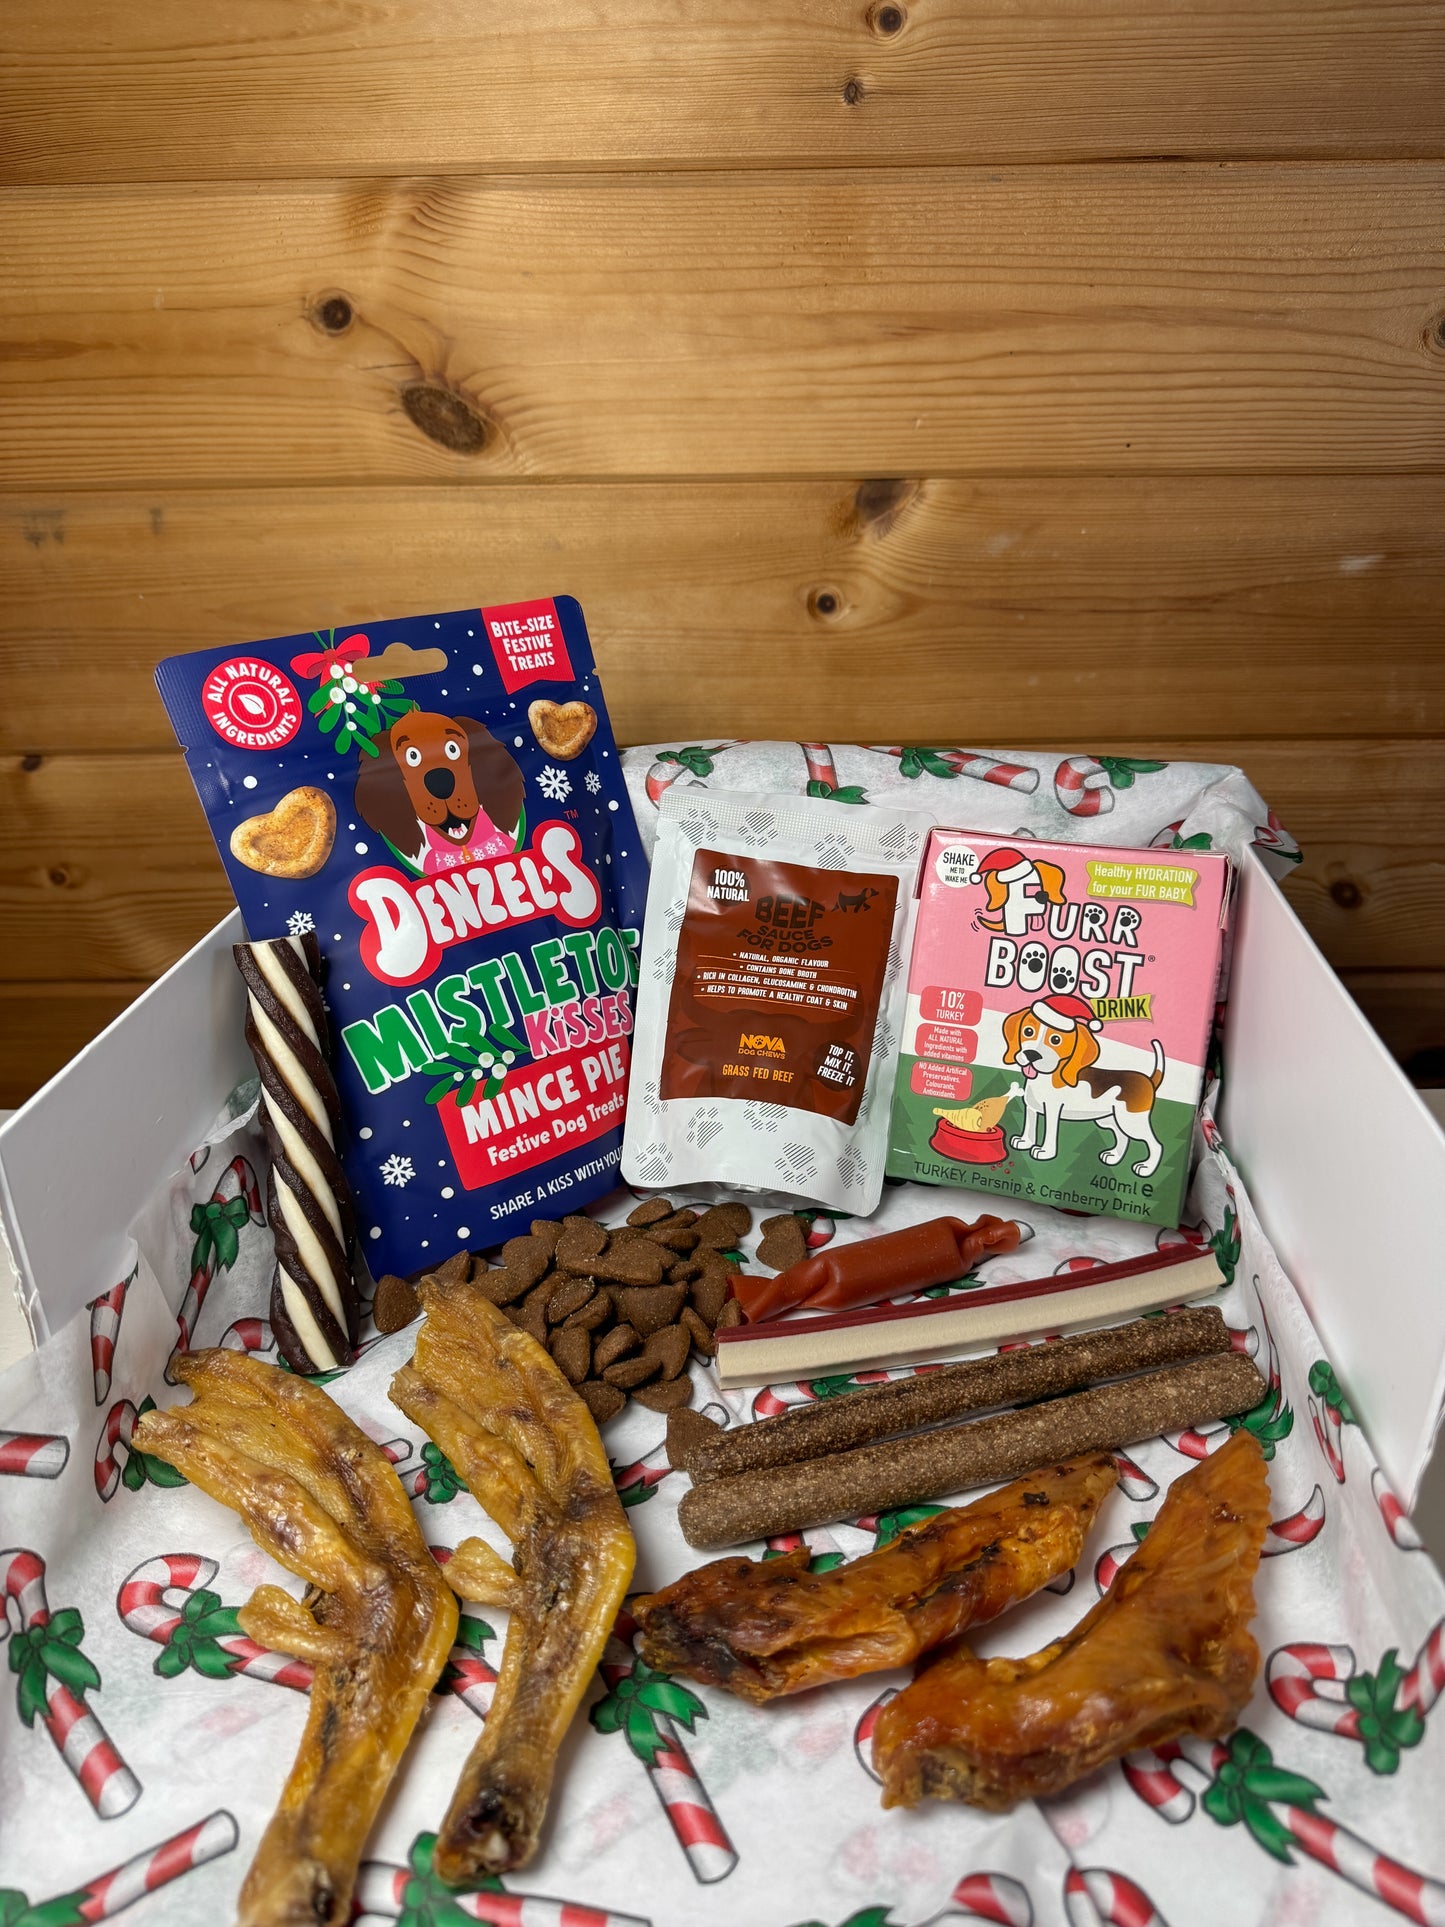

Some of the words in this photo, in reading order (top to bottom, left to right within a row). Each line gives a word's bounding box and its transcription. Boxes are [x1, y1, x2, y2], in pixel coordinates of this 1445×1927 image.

[490, 614, 555, 638] BITE-SIZE
[502, 633, 554, 655] FESTIVE
[508, 651, 556, 672] TREATS
[207, 676, 229, 704] ALL
[224, 662, 294, 706] NATURAL
[212, 711, 297, 746] INGREDIENTS
[942, 851, 976, 867] SHAKE
[714, 868, 746, 888] 100%
[945, 875, 959, 883] WAKE
[959, 876, 968, 884] ME
[958, 867, 965, 875] TO
[1094, 864, 1133, 882] Healthy
[1135, 867, 1193, 884] HYDRATION
[706, 885, 750, 902] NATURAL
[1092, 881, 1107, 894] for
[1109, 885, 1133, 897] your
[1135, 884, 1156, 898] FUR
[1158, 886, 1187, 900] BABY
[355, 826, 598, 978] DENZEL'S
[755, 893, 826, 929] BEEF
[1003, 862, 1143, 948] FURR
[736, 927, 775, 952] FOR
[777, 935, 834, 954] DOGS
[757, 925, 816, 941] SAUCE
[746, 964, 777, 974] CONTAINS
[778, 968, 795, 977] BONE
[797, 970, 818, 979] BROTH
[771, 955, 799, 965] ORGANIC
[800, 958, 830, 968] FLAVOUR
[984, 935, 1146, 1001] BOOST
[702, 971, 717, 981] RICH
[717, 973, 725, 981] IN
[762, 977, 807, 990] GLUCOSAMINE
[808, 983, 815, 991] &
[816, 984, 858, 999] CHONDROITIN
[706, 984, 726, 994] HELPS
[727, 986, 736, 994] TO
[737, 987, 767, 998] PROMOTE
[768, 990, 775, 999] A
[776, 991, 804, 1003] HEALTHY
[806, 995, 824, 1006] COAT
[824, 998, 831, 1006] &
[832, 1000, 848, 1011] SKIN
[940, 990, 966, 1010] 10%
[340, 926, 640, 1095] MISTLETOE
[935, 1008, 965, 1022] TURKEY
[1096, 998, 1148, 1019] DRINK
[928, 1034, 938, 1042] ALL
[939, 1035, 964, 1045] NATURAL
[933, 1026, 949, 1035] Made
[949, 1028, 962, 1037] with
[739, 1033, 786, 1052] NOVA
[828, 1044, 844, 1057] TOP
[955, 1046, 968, 1054] with
[737, 1047, 757, 1056] DOG
[757, 1049, 786, 1060] CHEWS
[824, 1055, 842, 1070] MIX
[923, 1050, 941, 1058] added
[722, 1063, 750, 1077] GRASS
[752, 1067, 769, 1080] FED
[772, 1068, 795, 1084] BEEF
[816, 1065, 846, 1083] FREEZE
[845, 1075, 856, 1087] IT
[927, 1063, 945, 1073] Added
[461, 1064, 581, 1145] MINCE
[581, 1043, 626, 1093] PIE
[487, 1129, 551, 1167] Festive
[552, 1113, 588, 1139] Dog
[586, 1091, 625, 1124] Treats
[489, 1190, 536, 1221] SHARE
[536, 1185, 548, 1199] A
[547, 1172, 575, 1196] KISS
[574, 1155, 604, 1183] WITH
[971, 1171, 1022, 1195] Parsnip
[1025, 1182, 1036, 1196] &
[1039, 1184, 1109, 1211] Cranberry
[1112, 1196, 1152, 1217] Drink
[1089, 1174, 1138, 1196] 400ml
